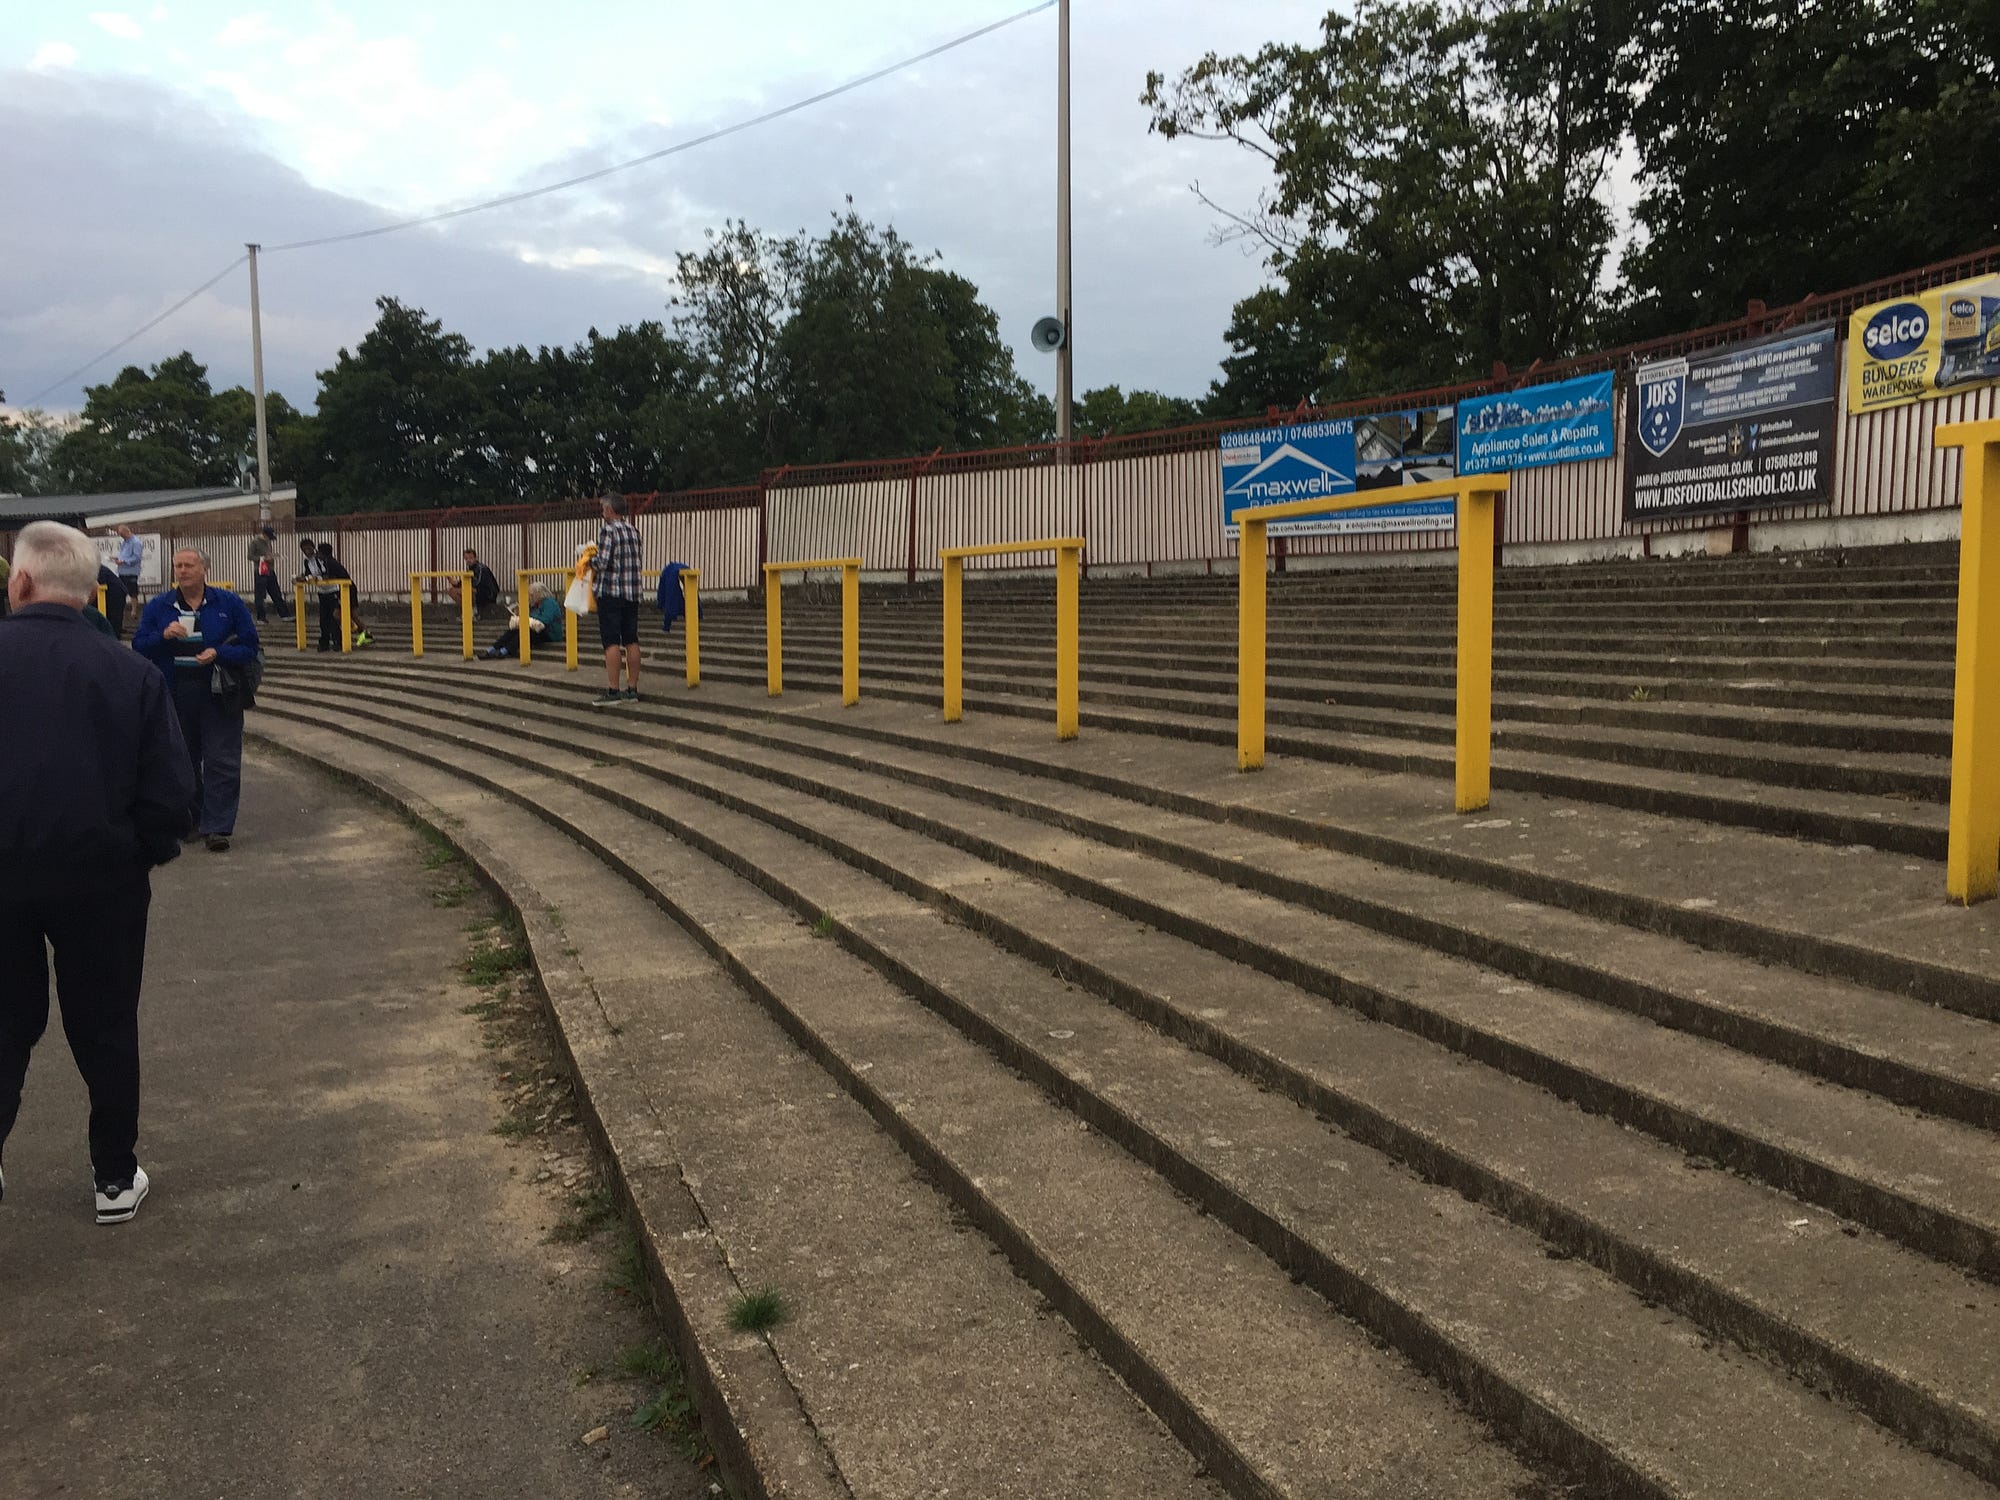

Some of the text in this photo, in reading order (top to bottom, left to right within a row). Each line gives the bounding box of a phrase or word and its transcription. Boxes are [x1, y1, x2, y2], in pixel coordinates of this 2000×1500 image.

[1951, 302, 1975, 313] selco
[1867, 315, 1925, 348] selco
[1862, 358, 1928, 386] BUILDERS
[1646, 380, 1677, 409] JDFS
[1472, 424, 1599, 457] Appliance Sales & Repairs
[1249, 471, 1329, 499] maxwell
[1635, 468, 1817, 510] WWW.JDSFOOTBALLSCHOOL.CO.UK
